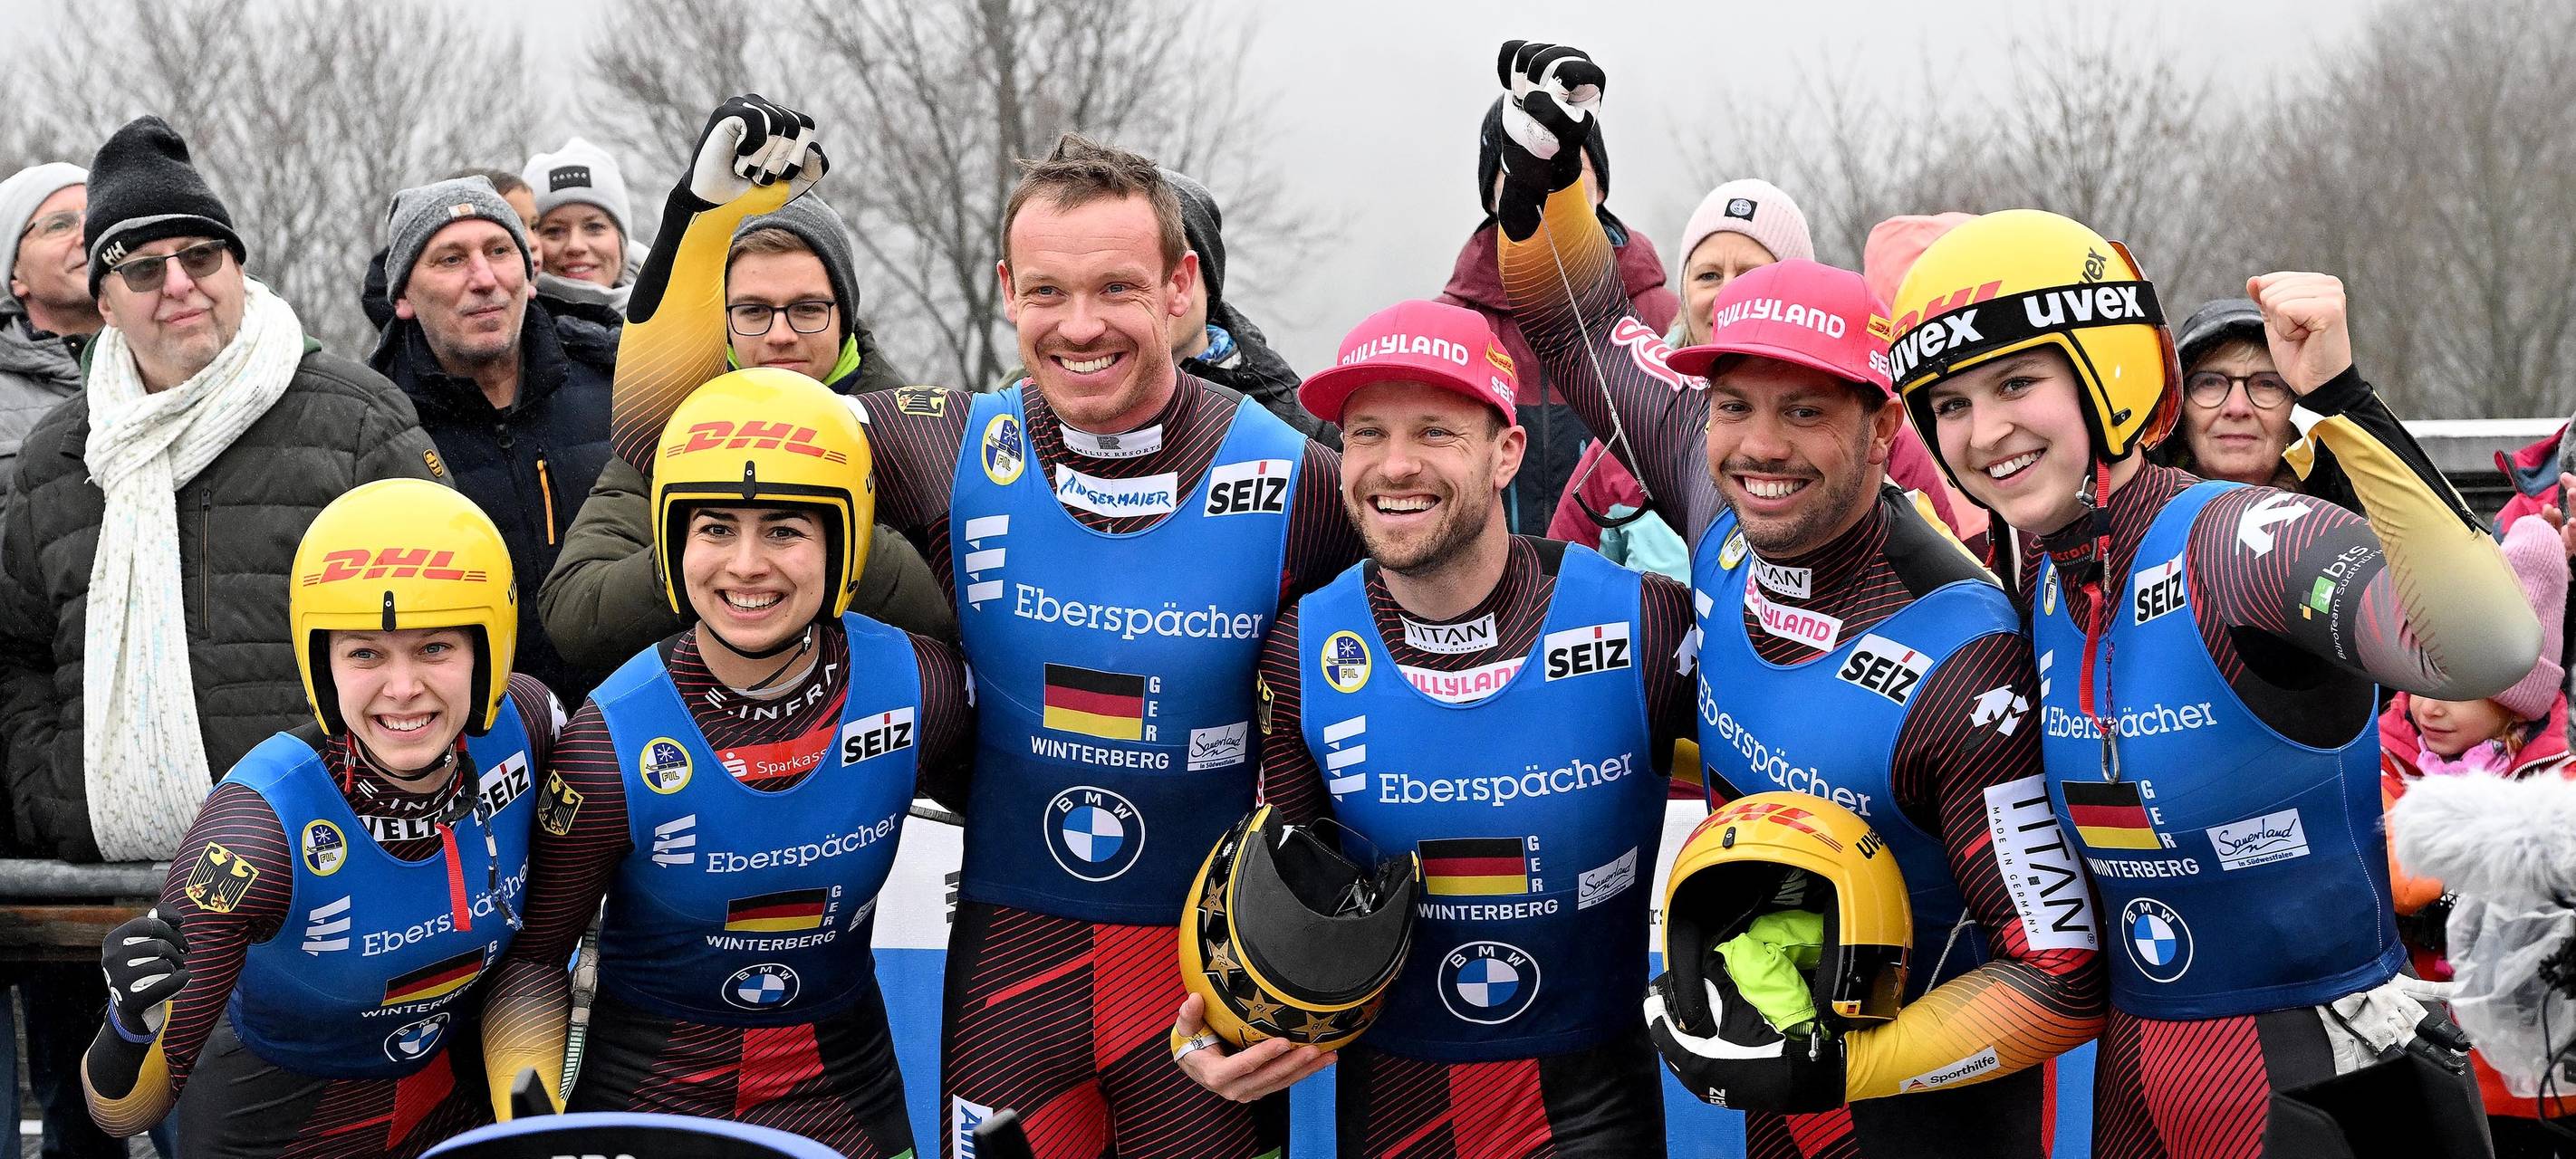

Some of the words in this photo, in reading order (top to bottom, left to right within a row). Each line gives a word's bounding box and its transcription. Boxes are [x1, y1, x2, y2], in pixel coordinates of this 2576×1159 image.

[101, 241, 127, 264] HH
[1716, 298, 1846, 340] BULLYLAND
[2023, 285, 2146, 329] uvex
[1889, 309, 1985, 382] uvex
[1869, 350, 1892, 382] SEI
[684, 420, 826, 459] DHL
[1114, 444, 1160, 458] RESORTS
[995, 453, 1014, 474] FIL
[1059, 473, 1172, 509] ANGERMAIER
[1206, 461, 1289, 515] SEIZ
[320, 548, 466, 584] DHL
[2322, 545, 2369, 579] bts
[2337, 549, 2383, 596] Südthüri
[2136, 561, 2186, 622] SEIZ
[1014, 581, 1264, 641] Eberspächer
[1548, 626, 1630, 679] SEIZ
[1340, 667, 1359, 679] FIL
[1841, 650, 1920, 704] SEIZ
[843, 712, 913, 765] SEIZ
[1031, 734, 1170, 771] WINTERBERG
[1190, 725, 1247, 759] Sauerland
[1697, 673, 1872, 818] Eberspächer
[660, 770, 680, 783] FIL
[755, 747, 827, 776] Sparkass
[1378, 752, 1633, 807] Eberspächer
[476, 762, 531, 821] SEIZ
[1056, 790, 1133, 820] BMW
[706, 812, 898, 874] Eberspächer
[1855, 824, 1885, 860] uve
[2218, 818, 2297, 857] Sauerland
[319, 851, 337, 864] FIL
[1993, 805, 2007, 844] MADE
[2003, 852, 2014, 866] IN
[2009, 873, 2040, 934] GERMANY
[2012, 781, 2091, 933] TITAN
[2086, 857, 2201, 878] WINTERBERG
[2246, 850, 2294, 867] Südwestfalen
[1580, 854, 1637, 898] Sauerland
[361, 854, 530, 957] Ebersähe
[1417, 897, 1559, 922] WINTERBERG
[2125, 901, 2175, 925] BMW
[706, 930, 838, 952] WINTERBERG
[1449, 944, 1527, 970] BMW
[736, 964, 793, 982] BMW
[1930, 1056, 1995, 1084] Sporthilfe
[1709, 1087, 1726, 1106] EIZ
